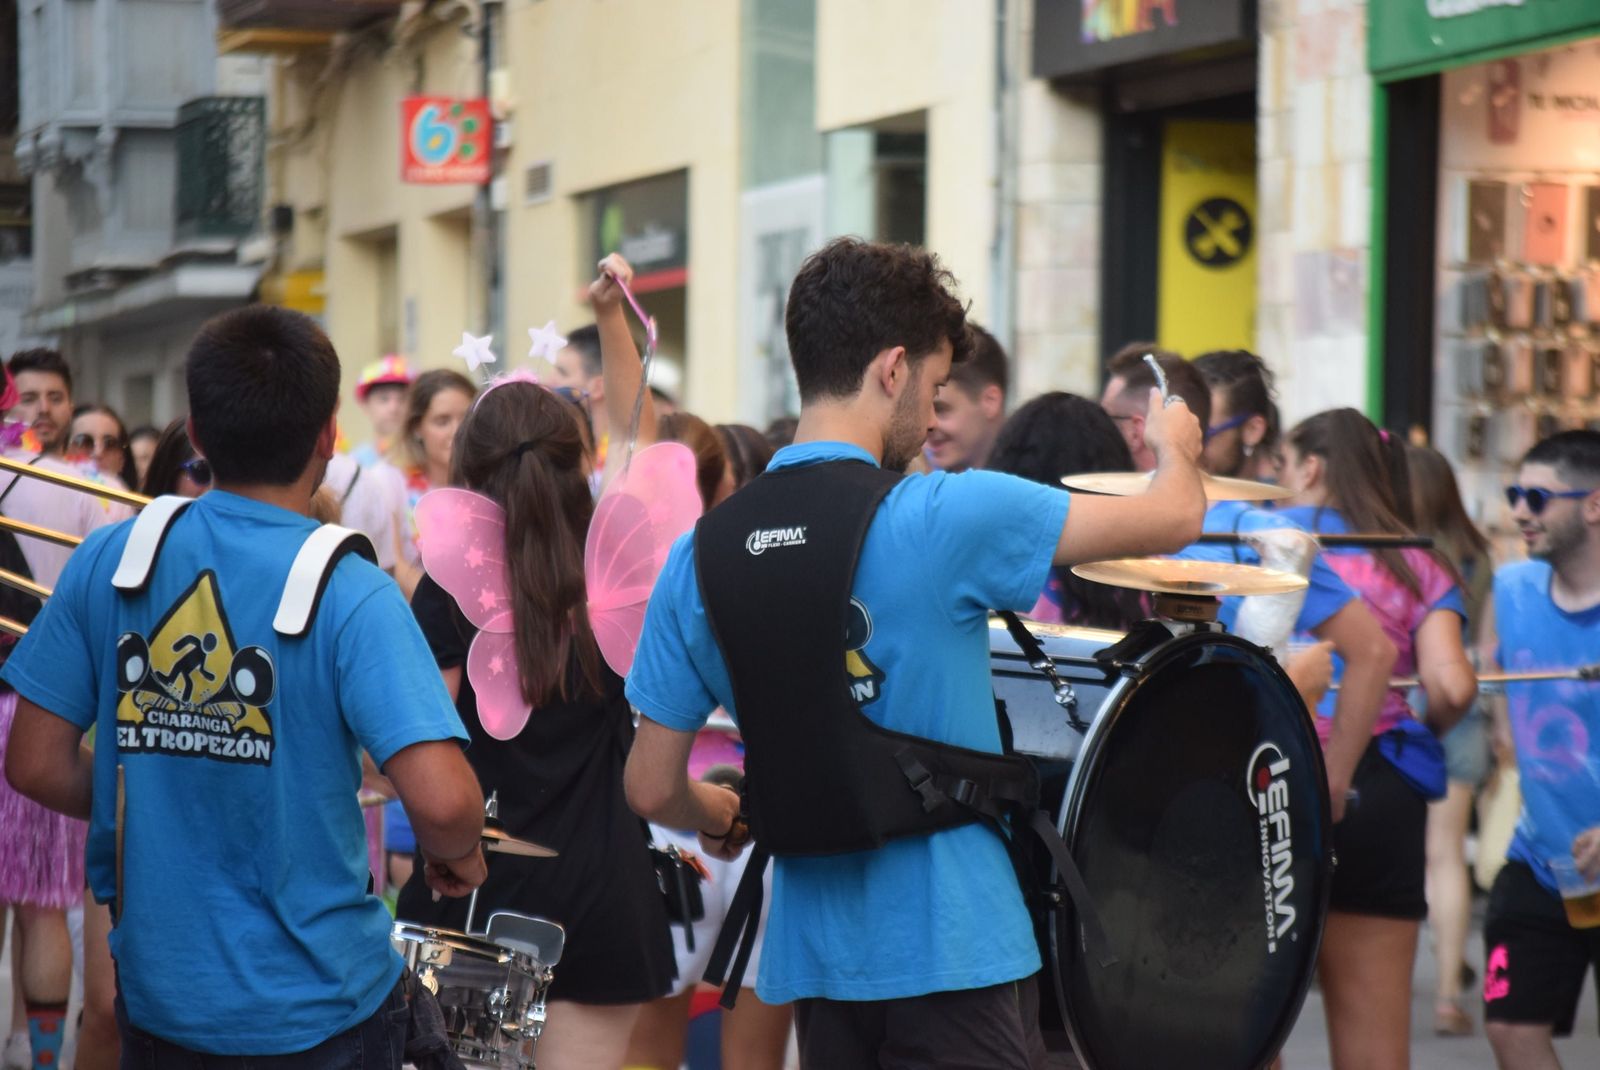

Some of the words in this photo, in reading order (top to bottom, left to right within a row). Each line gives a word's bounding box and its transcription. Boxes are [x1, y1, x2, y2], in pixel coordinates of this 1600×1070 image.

[410, 103, 458, 165] 6
[116, 726, 140, 748] EL
[142, 728, 270, 760] TROPEZÓN
[147, 710, 231, 734] CHARANGA
[1259, 818, 1275, 938] INNOVATION
